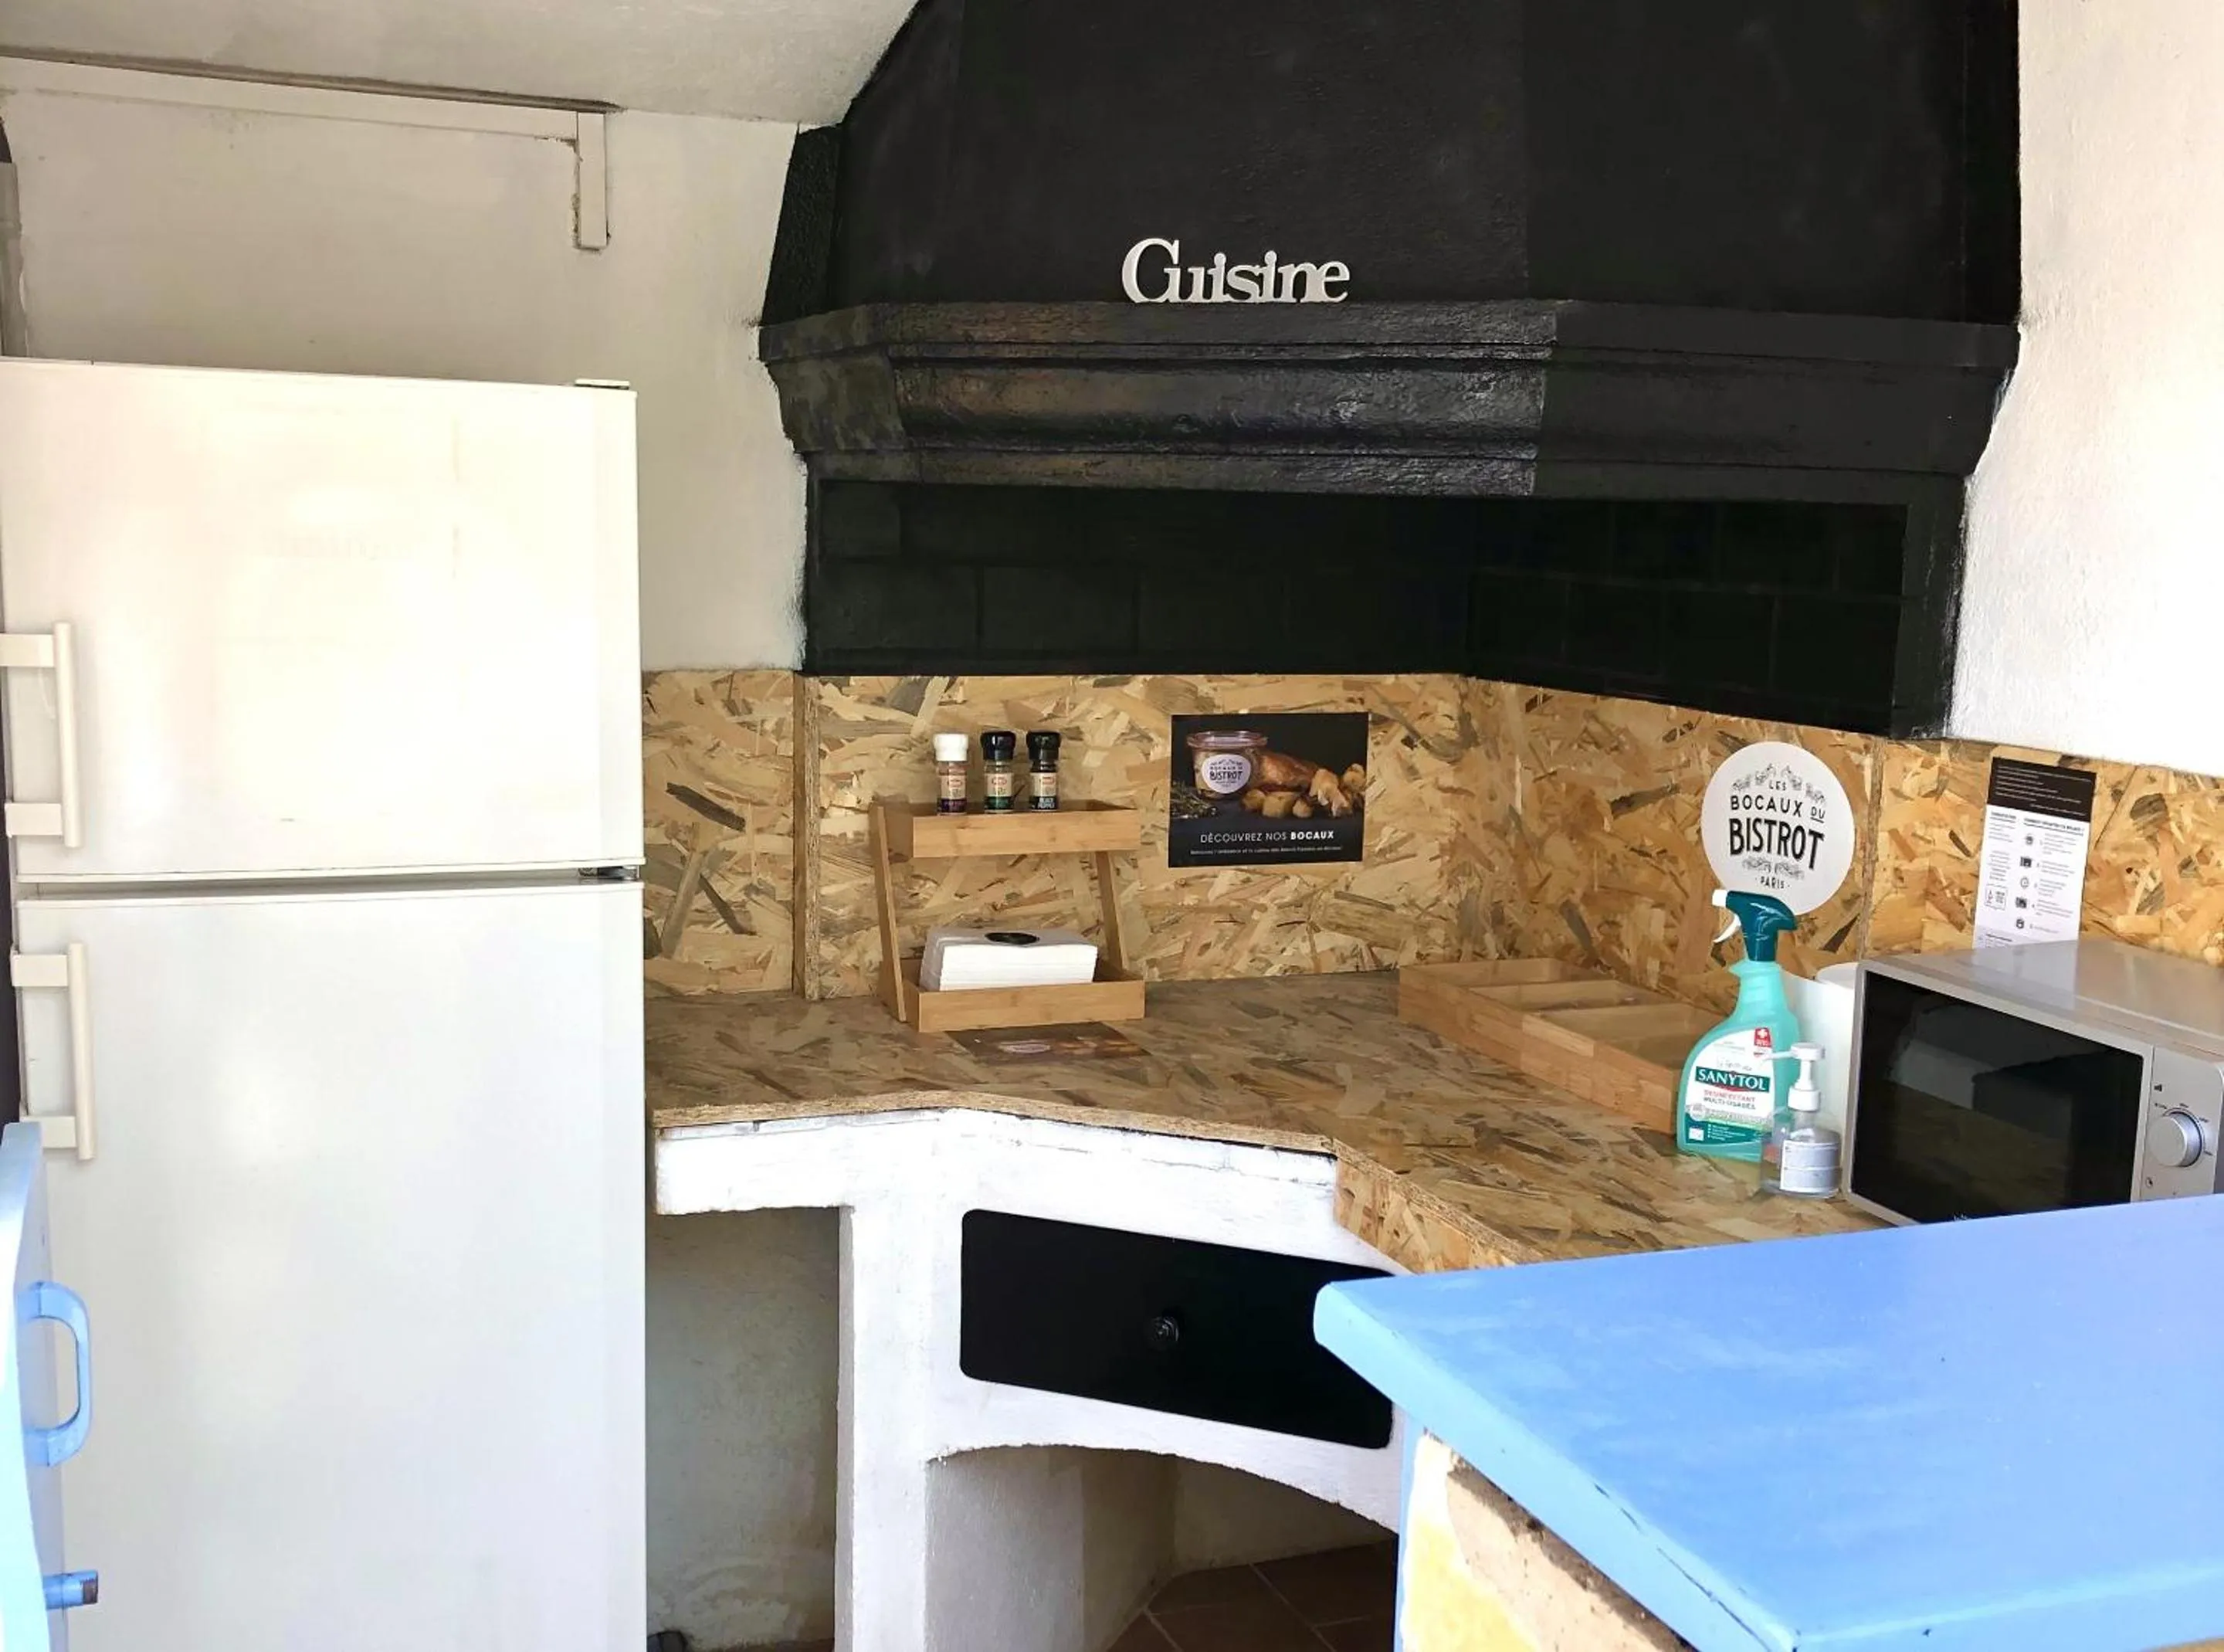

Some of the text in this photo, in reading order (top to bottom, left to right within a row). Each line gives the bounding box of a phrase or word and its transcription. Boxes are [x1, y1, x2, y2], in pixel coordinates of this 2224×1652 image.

[1122, 238, 1350, 304] Cuisine
[1768, 780, 1787, 792] LES
[1731, 795, 1826, 820] BOCAUX DU
[1200, 830, 1334, 843] DÉCOUVREZ NOS BOCAUX
[1729, 817, 1826, 870] BISTROT
[1761, 876, 1785, 889] PARIS
[1698, 1068, 1767, 1091] SANYTOL
